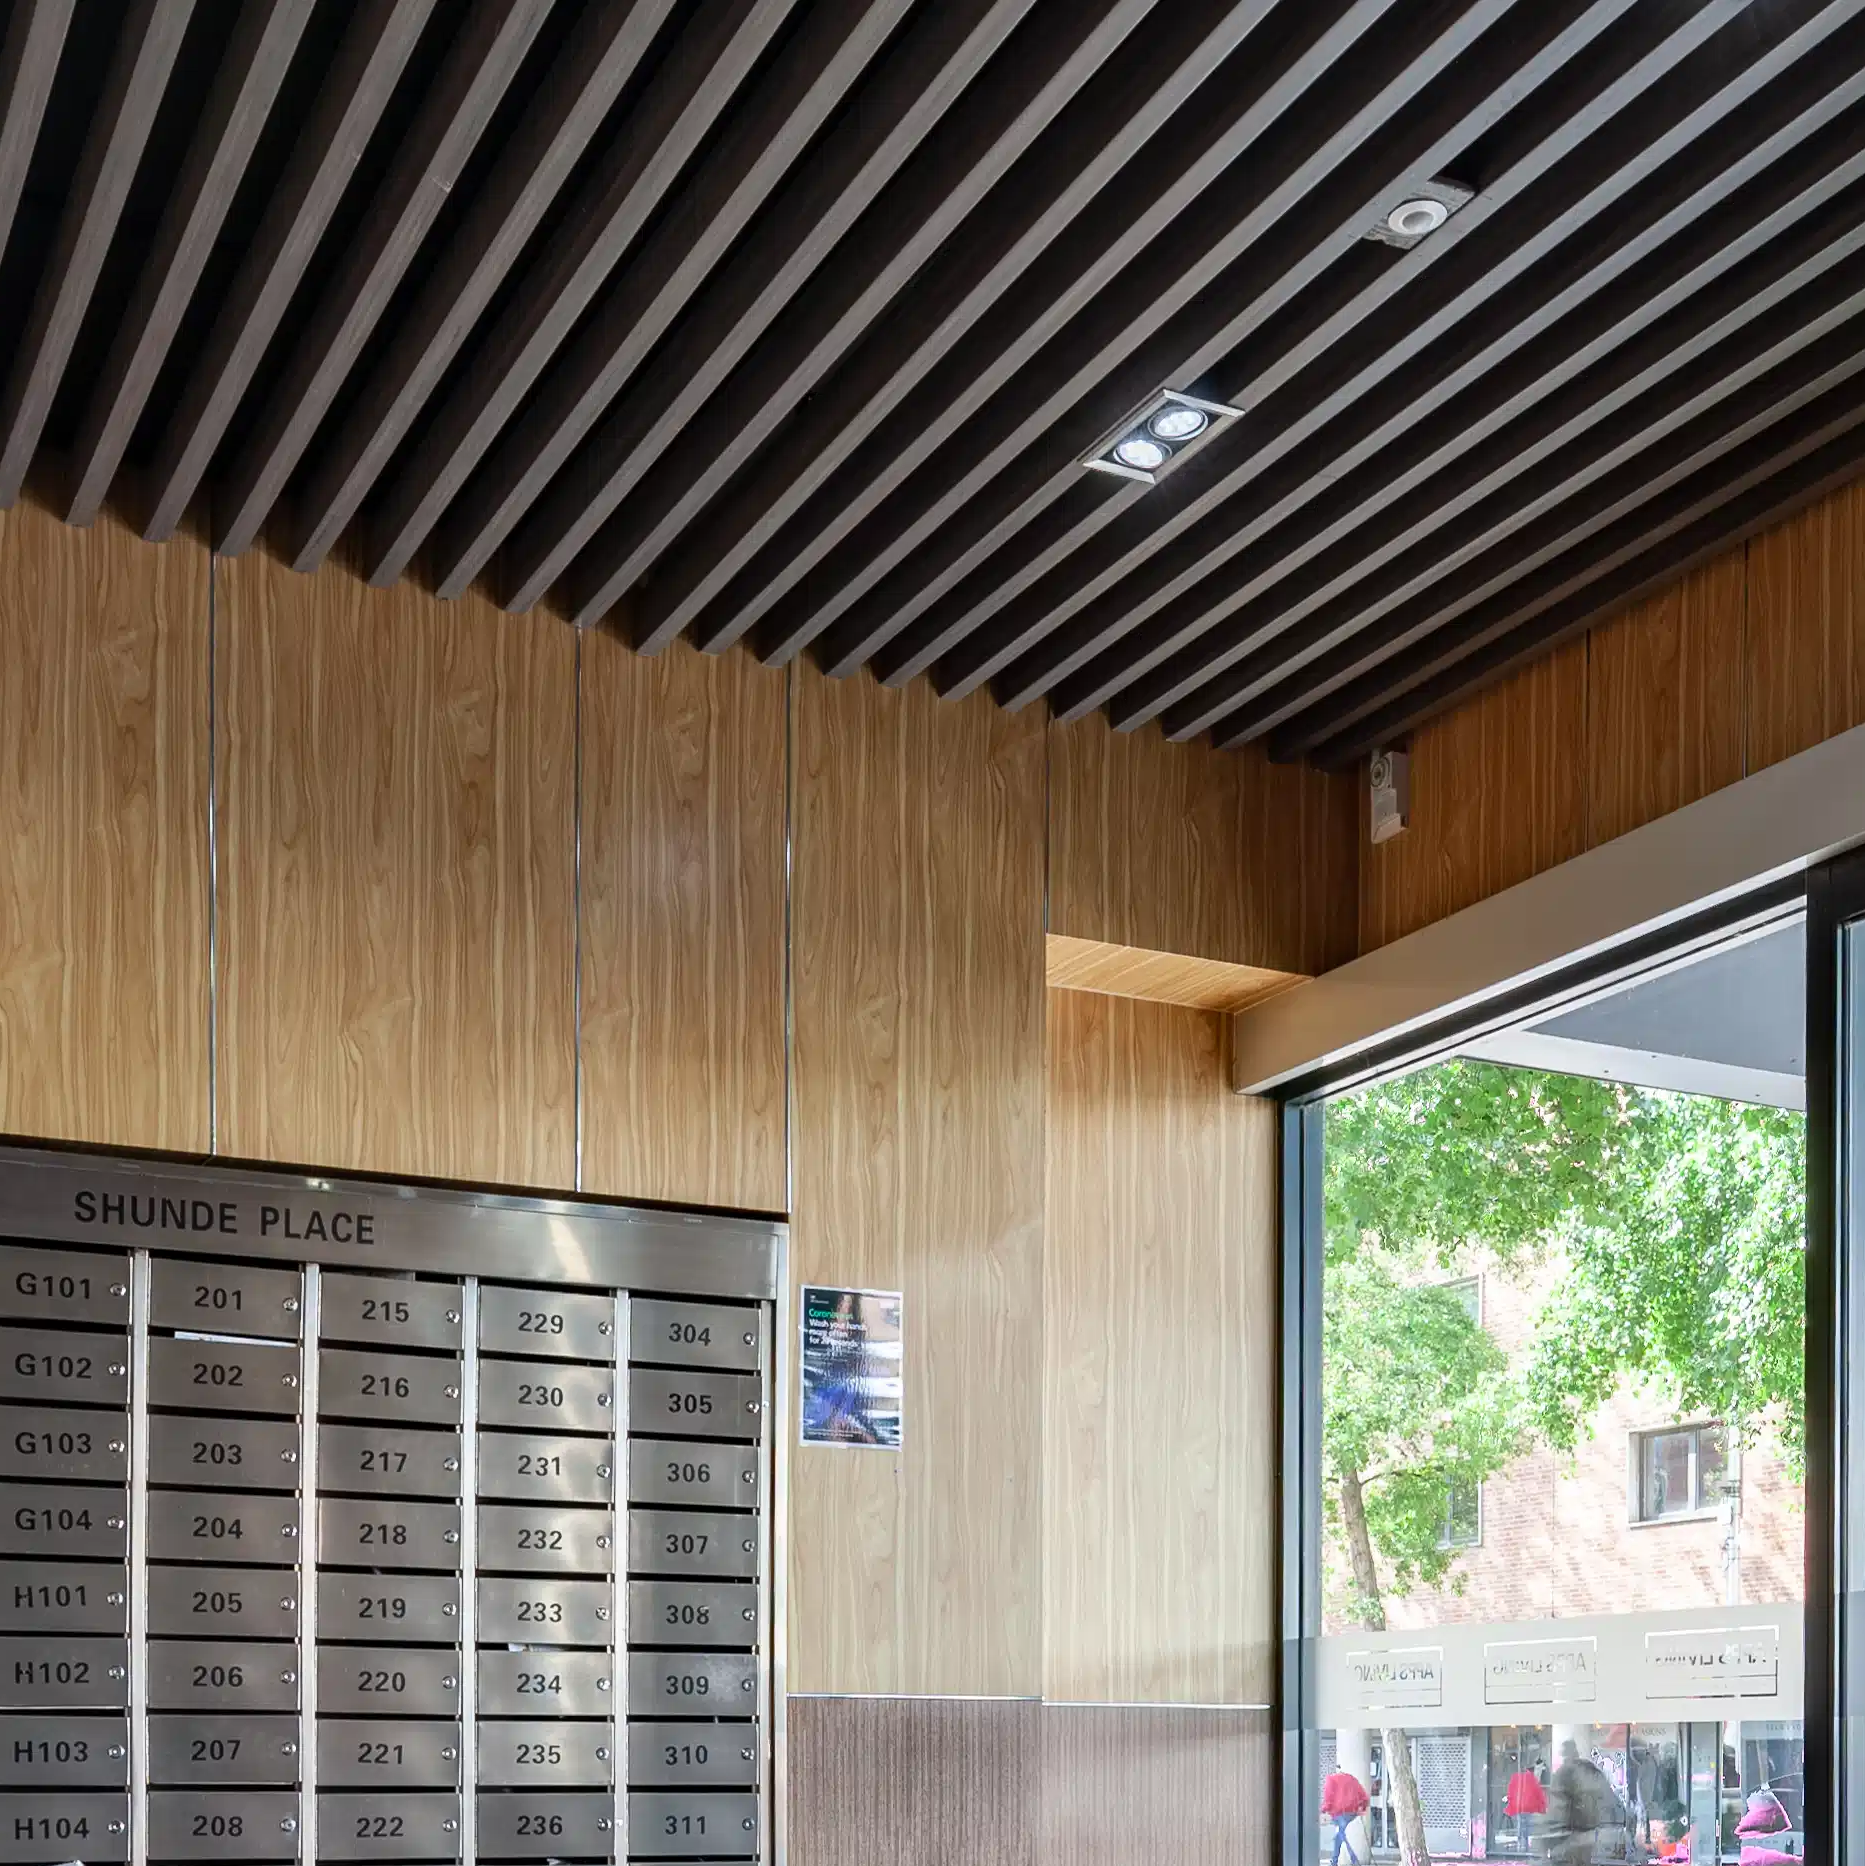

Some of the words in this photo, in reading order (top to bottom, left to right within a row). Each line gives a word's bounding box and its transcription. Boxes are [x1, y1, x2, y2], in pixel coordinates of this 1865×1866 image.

[74, 1190, 238, 1235] SHUNDE
[260, 1205, 375, 1245] PLACE
[15, 1272, 90, 1300] G101
[194, 1285, 242, 1312] 201
[361, 1299, 410, 1323] 215
[517, 1311, 564, 1334] 229
[668, 1322, 712, 1347] 304
[14, 1353, 92, 1379] G102
[193, 1362, 244, 1387] 202
[361, 1374, 410, 1398] 216
[517, 1384, 564, 1407] 230
[668, 1392, 713, 1415] 305
[14, 1431, 92, 1455] G103
[192, 1442, 243, 1465] 203
[359, 1449, 408, 1473] 217
[517, 1454, 560, 1477] 231
[667, 1462, 711, 1483] 306
[14, 1507, 93, 1531] G104
[192, 1515, 244, 1540] 204
[359, 1523, 407, 1546] 218
[517, 1528, 563, 1551] 232
[665, 1533, 709, 1555] 307
[14, 1585, 87, 1609] H101
[192, 1591, 243, 1614] 205
[358, 1597, 406, 1619] 219
[517, 1601, 563, 1623] 233
[665, 1604, 710, 1625] 308
[14, 1661, 90, 1685] H102
[192, 1665, 244, 1688] 206
[357, 1670, 406, 1693] 220
[516, 1672, 562, 1695] 234
[665, 1675, 709, 1696] 309
[13, 1740, 89, 1763] H103
[191, 1739, 241, 1761] 207
[357, 1742, 403, 1765] 221
[515, 1743, 561, 1765] 235
[664, 1744, 709, 1766] 310
[14, 1817, 91, 1841] H104
[192, 1815, 243, 1837] 208
[356, 1816, 404, 1838] 222
[516, 1815, 563, 1836] 236
[664, 1815, 706, 1835] 311
